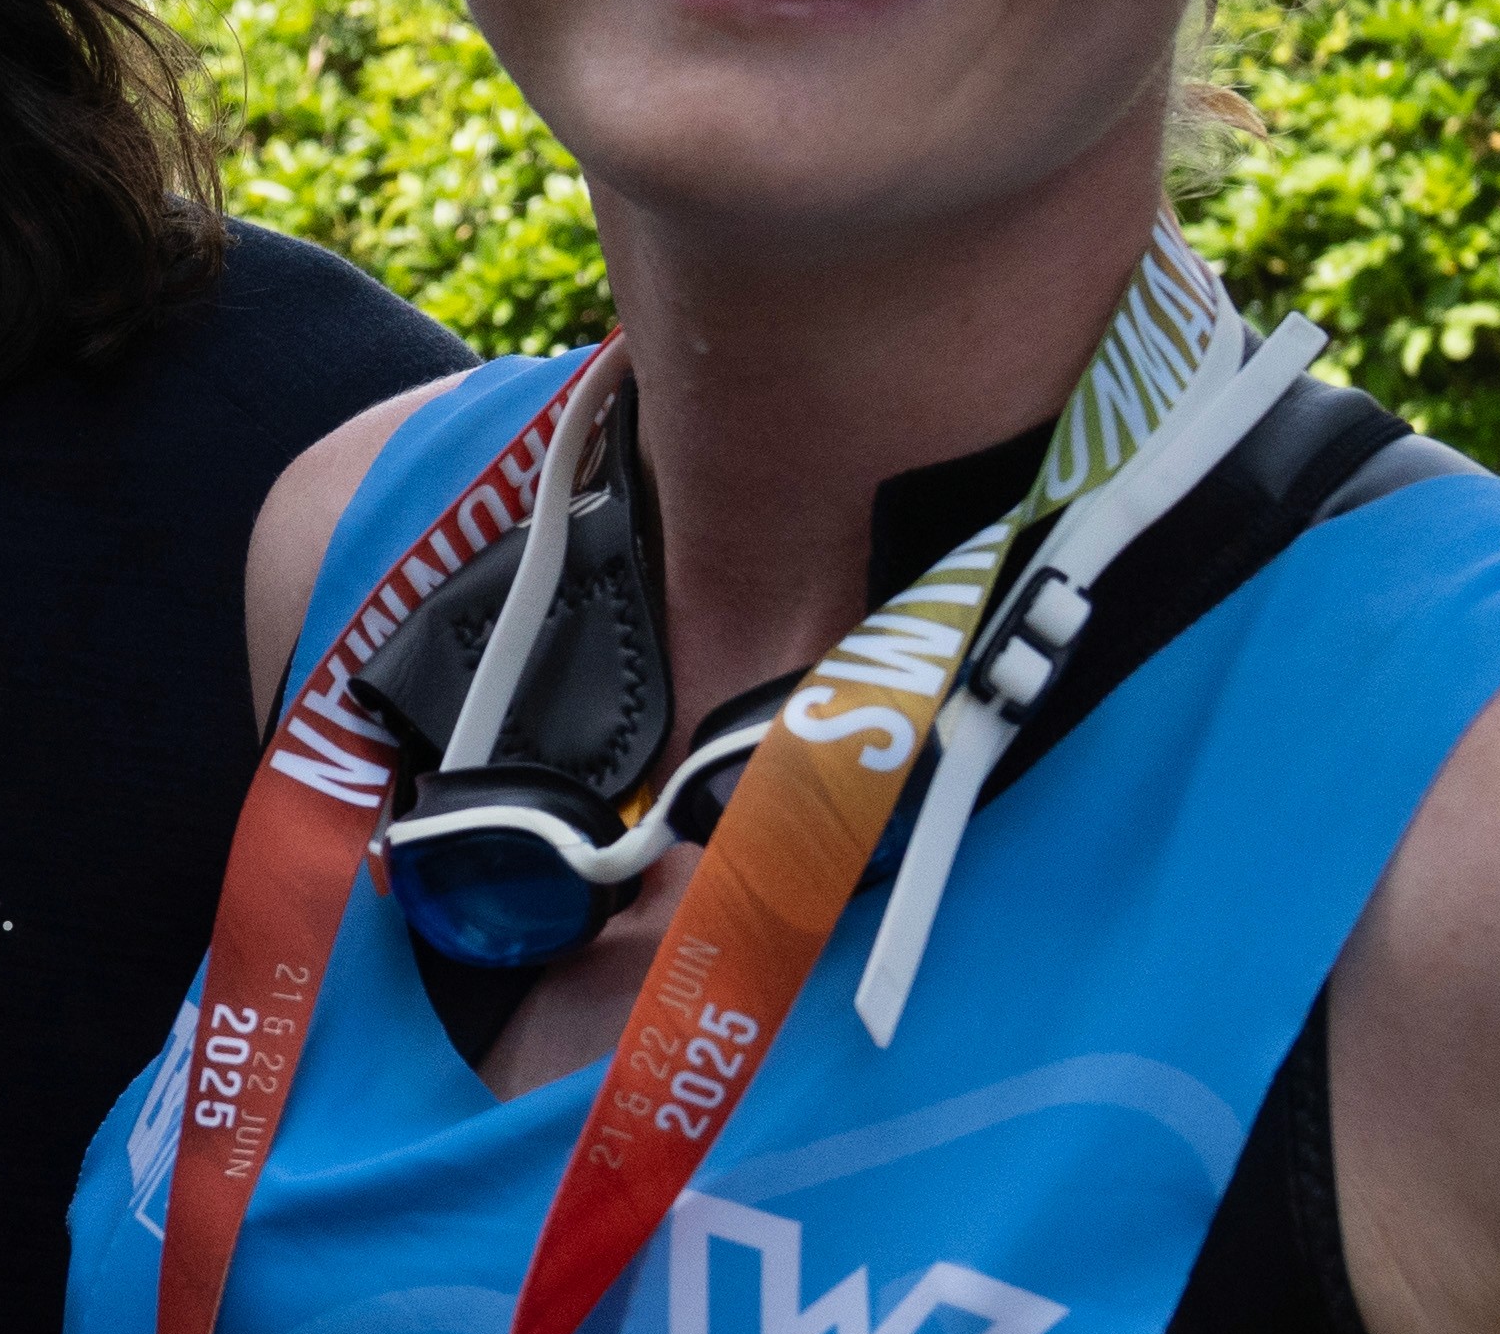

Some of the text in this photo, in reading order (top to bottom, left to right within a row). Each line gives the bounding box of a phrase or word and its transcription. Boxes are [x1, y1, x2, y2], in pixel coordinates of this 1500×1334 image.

[272, 963, 311, 1002] 21
[194, 1003, 258, 1129] 2025
[247, 1051, 285, 1094] 22
[588, 1125, 633, 1170] 21
[630, 1026, 681, 1081] 22
[655, 1002, 760, 1141] 2025
[225, 1109, 267, 1179] JUIN
